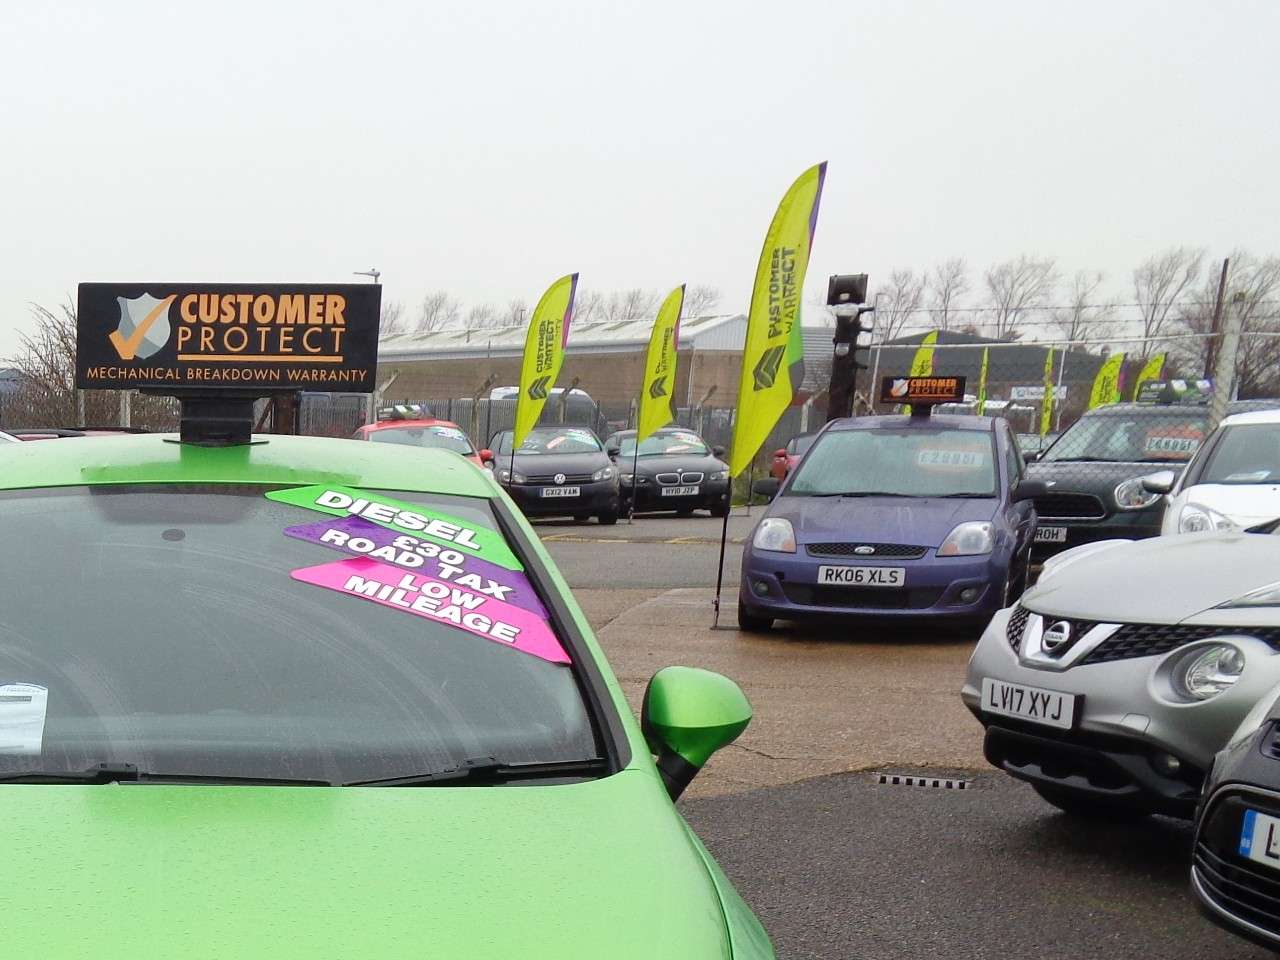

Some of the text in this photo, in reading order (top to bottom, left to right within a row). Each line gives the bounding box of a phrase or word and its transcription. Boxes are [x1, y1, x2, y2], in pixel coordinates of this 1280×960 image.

[180, 293, 347, 325] CUSTOMER
[177, 326, 346, 352] PROTECT
[86, 366, 368, 382] MECHANICAL BREAKDOWN WARRANTY
[314, 490, 480, 550] DIESEL
[319, 529, 513, 600] ROAD TAX
[392, 535, 465, 566] £30
[397, 574, 487, 610] LOW
[824, 569, 899, 583] RK06 XLS
[343, 575, 521, 644] MILEAGE
[990, 682, 1063, 721] LV17 XYJ
